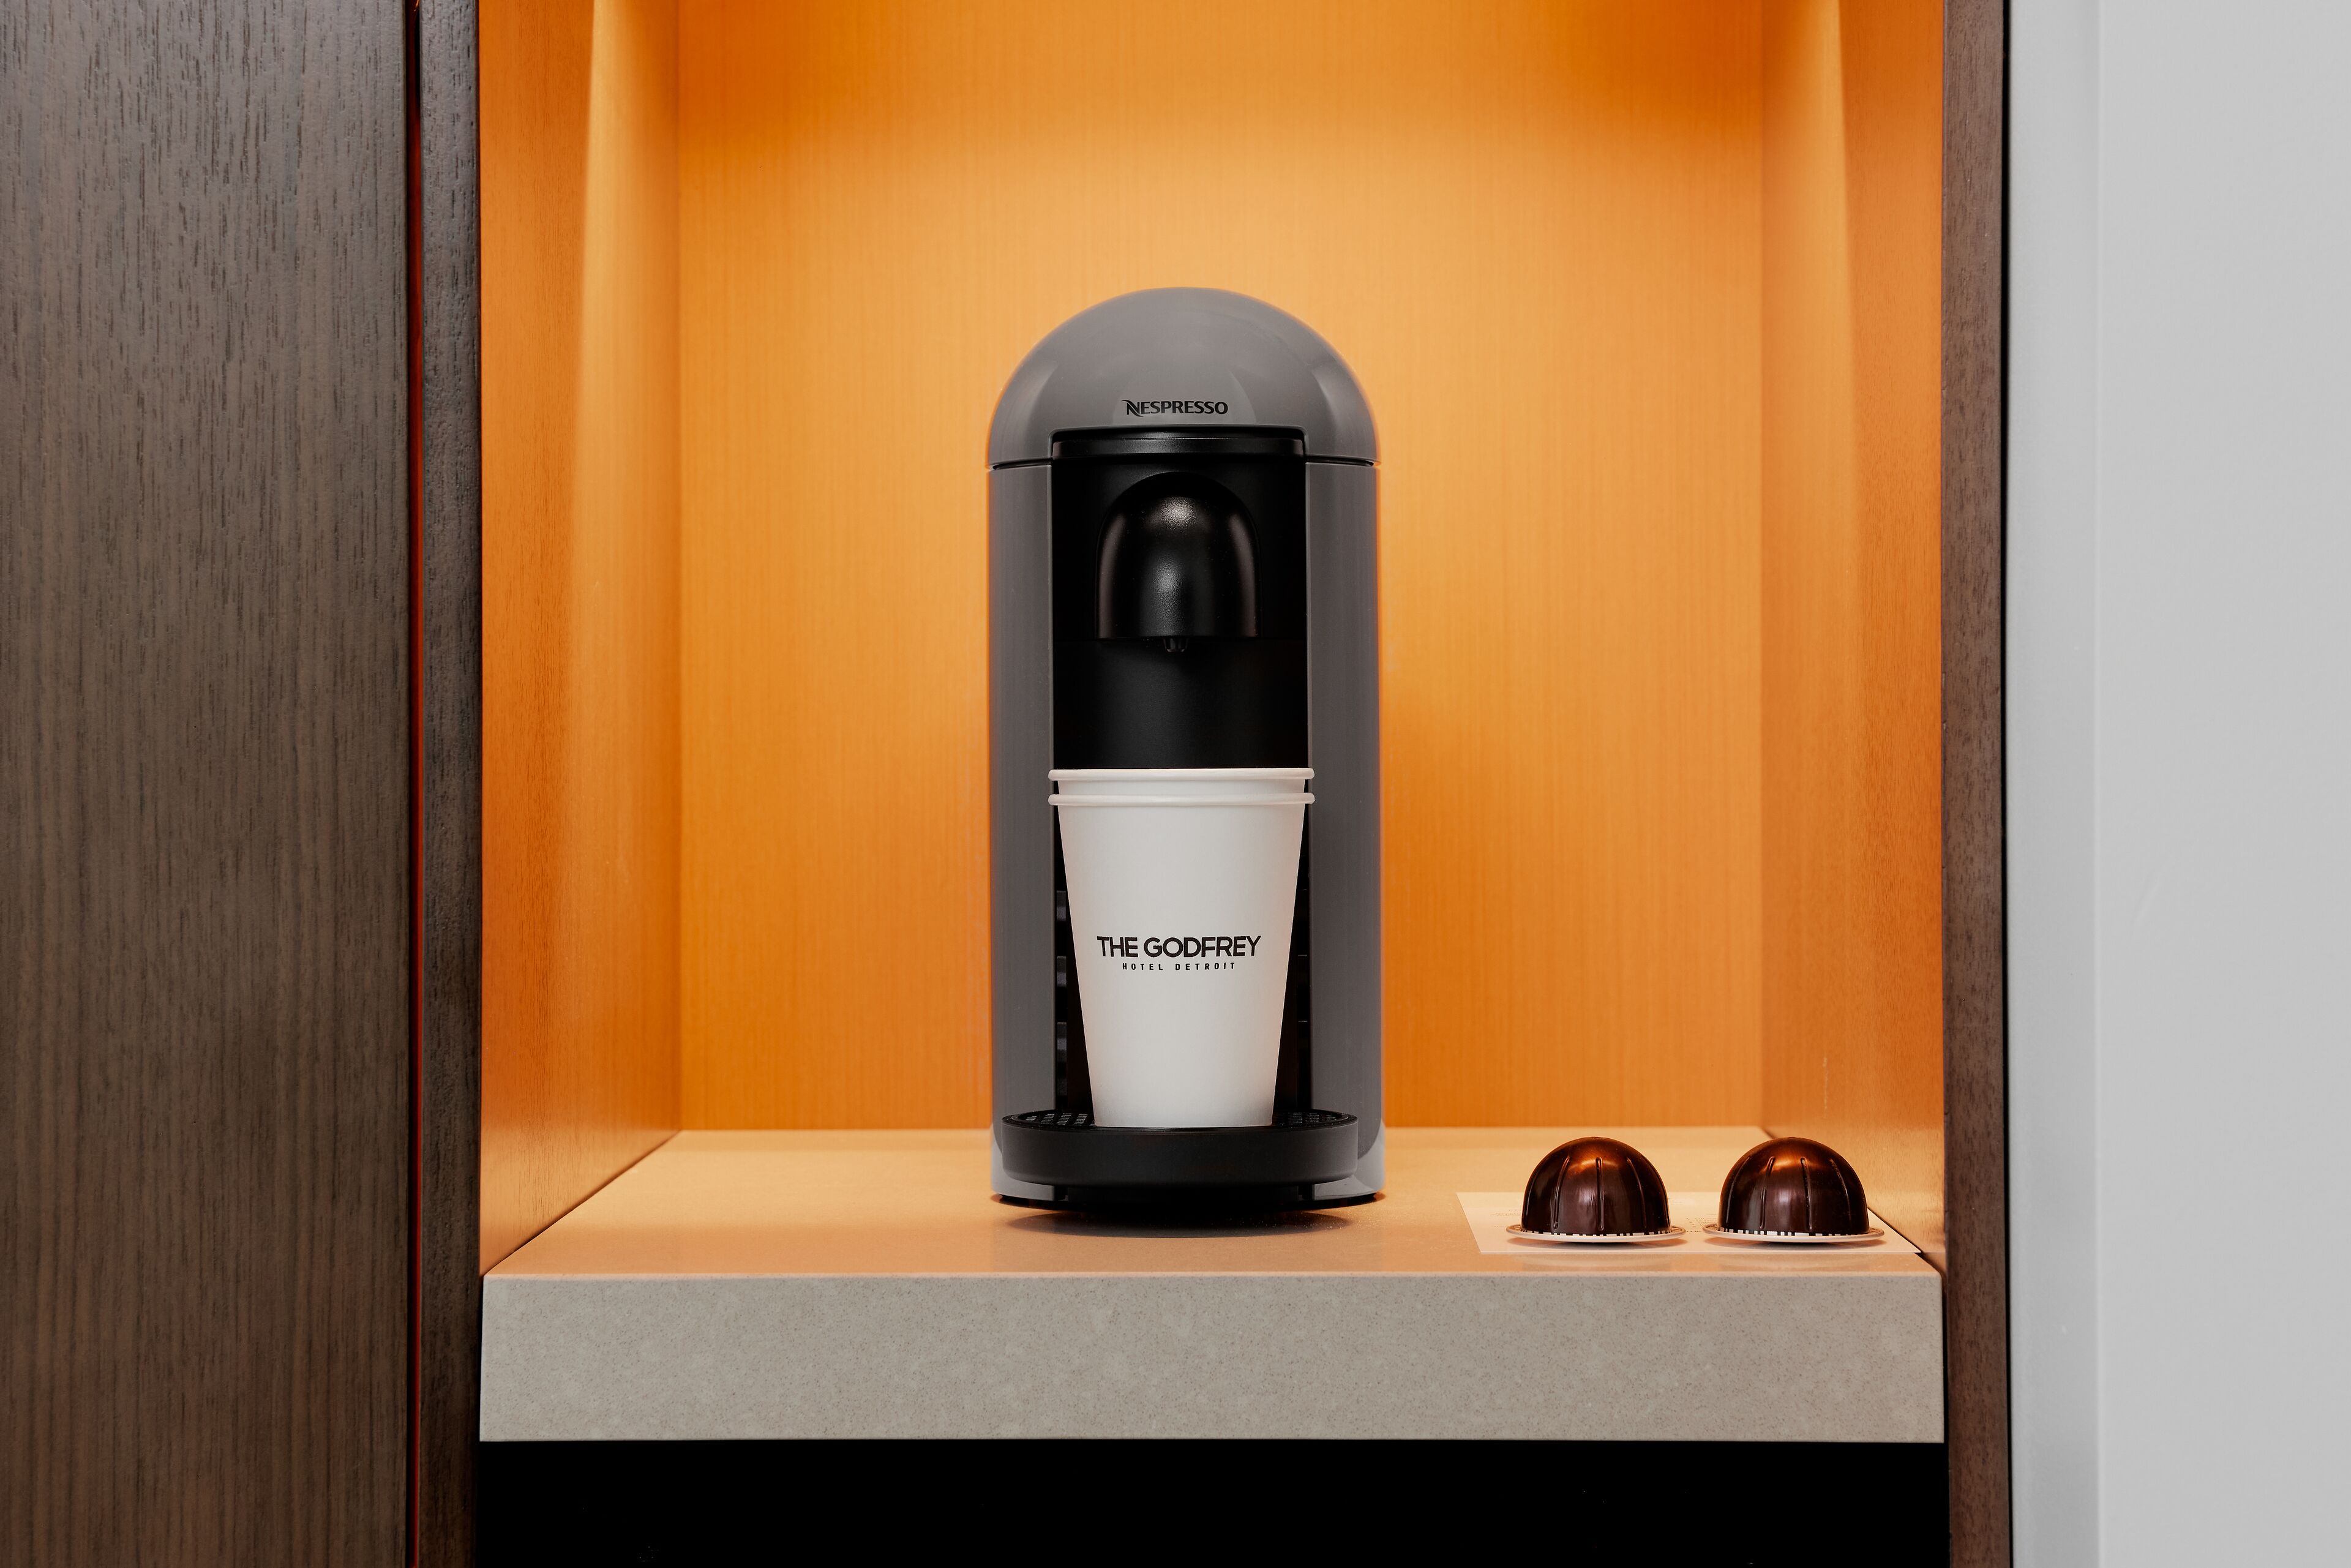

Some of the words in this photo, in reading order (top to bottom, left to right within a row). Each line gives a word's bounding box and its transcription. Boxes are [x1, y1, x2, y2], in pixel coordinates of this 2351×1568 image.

[1122, 400, 1229, 417] NESPRESSO
[1097, 936, 1139, 958] THE
[1143, 935, 1262, 958] GODFREY
[1175, 962, 1235, 970] DETROIT
